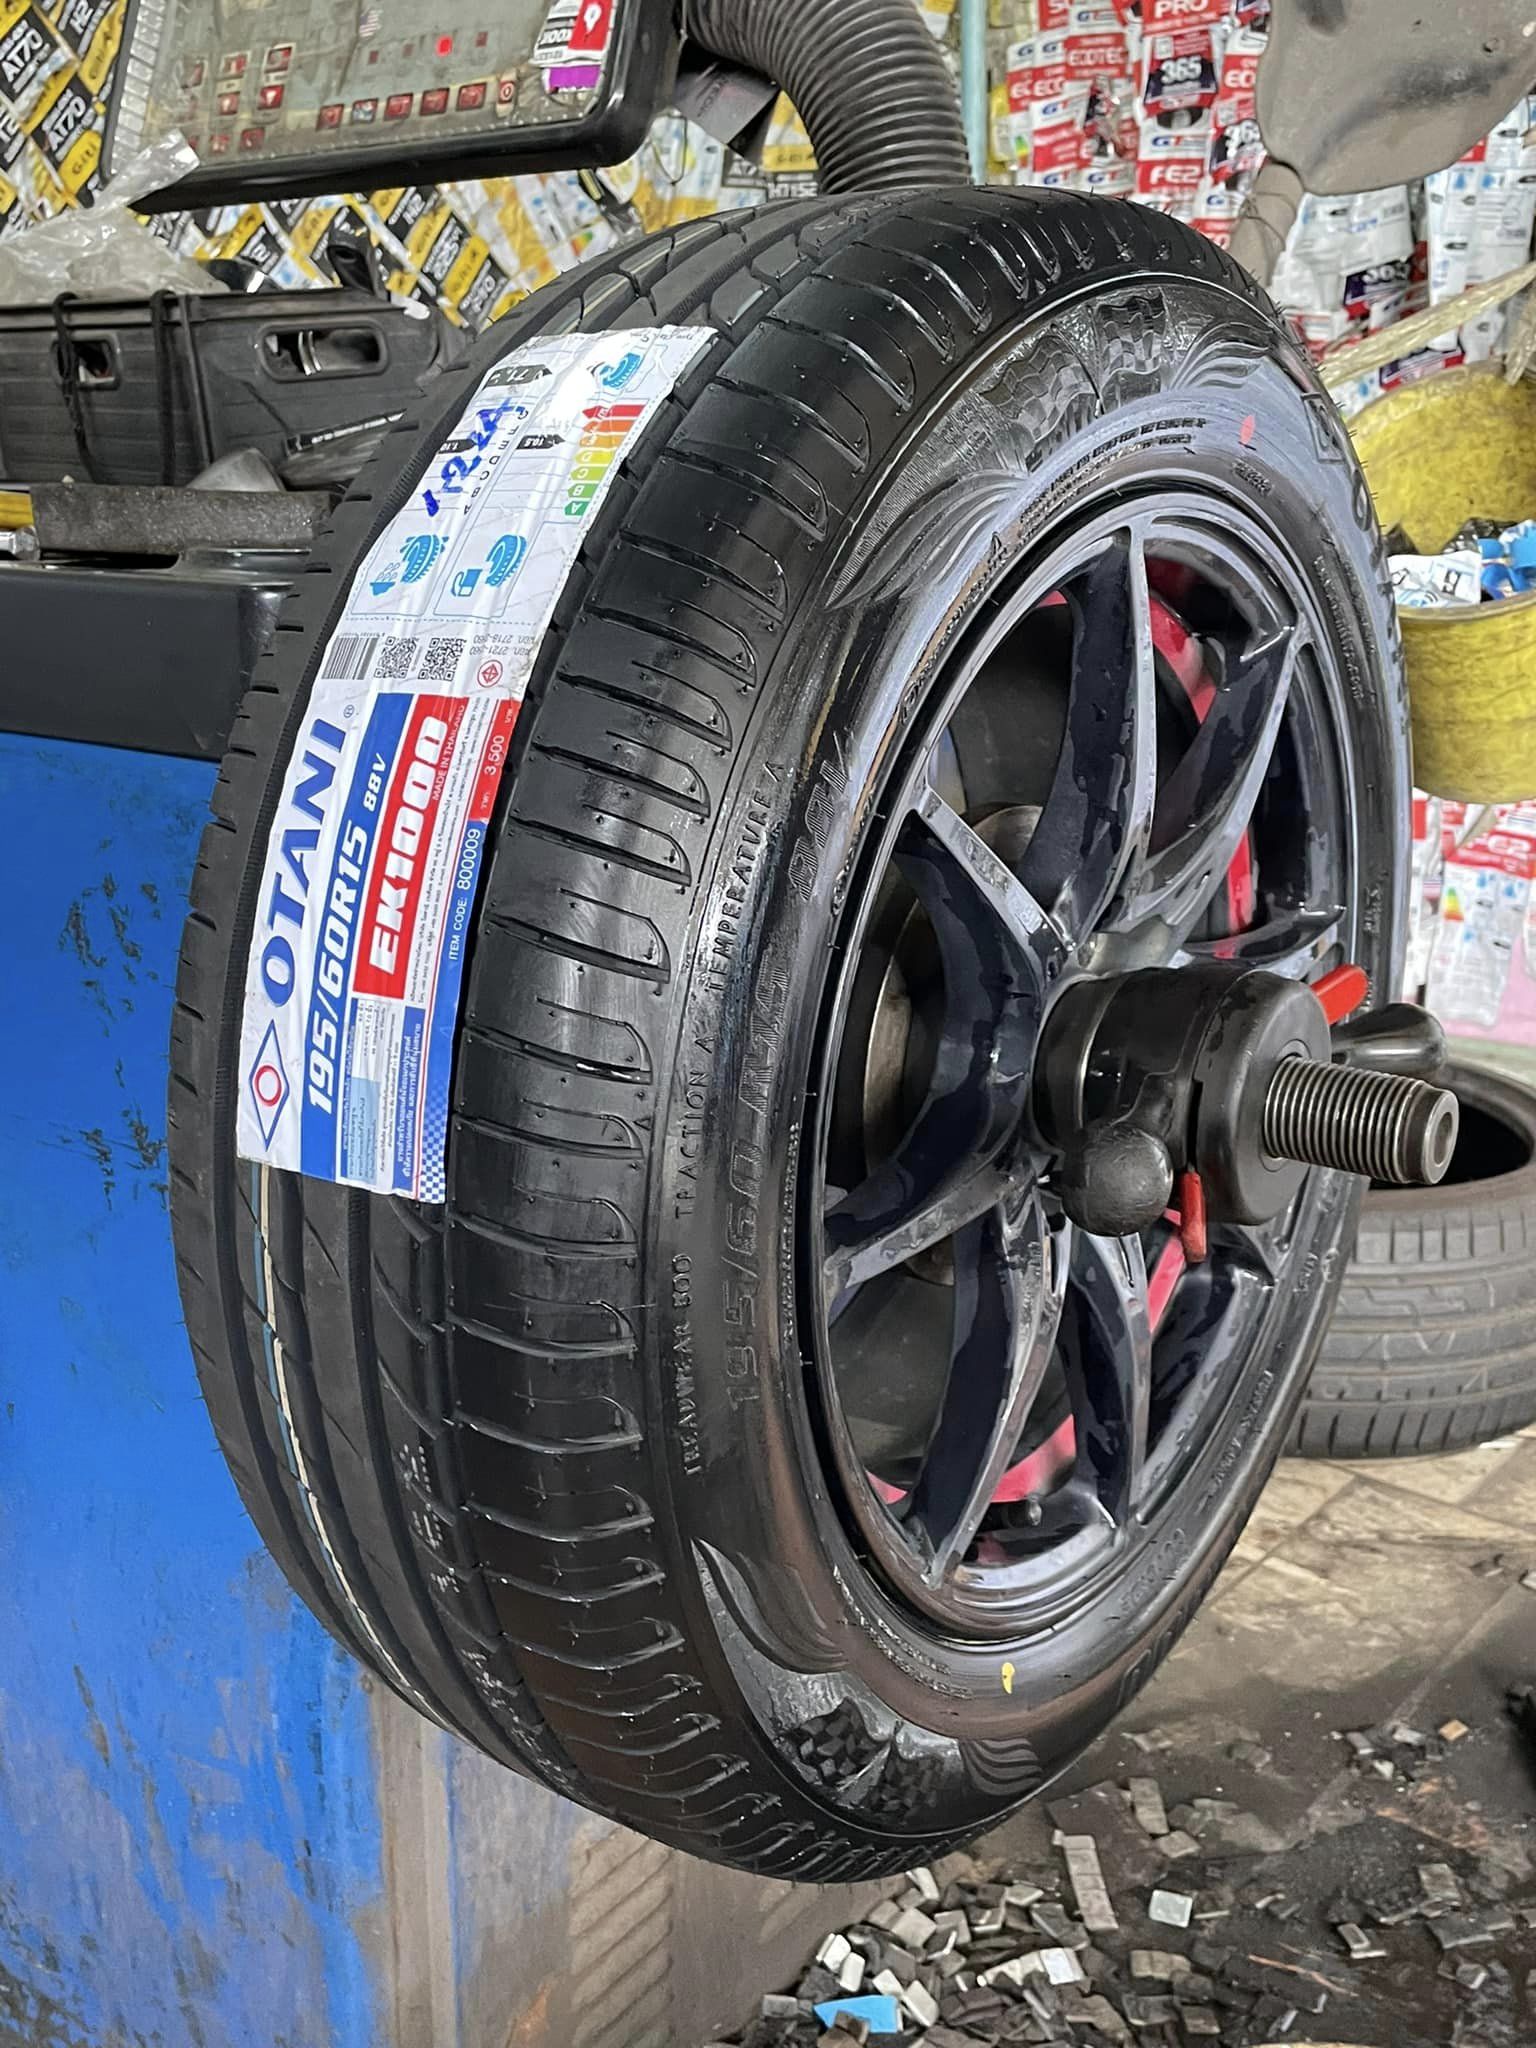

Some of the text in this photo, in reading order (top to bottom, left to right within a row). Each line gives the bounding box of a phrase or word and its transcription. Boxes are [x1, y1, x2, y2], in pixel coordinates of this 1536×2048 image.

[1, 28, 43, 83] AT70
[1160, 55, 1202, 84] 365
[48, 95, 87, 151] AT70
[489, 455, 500, 465] D
[479, 470, 490, 481] C
[471, 487, 480, 498] B
[572, 486, 584, 497] B
[569, 502, 579, 514] A
[762, 759, 785, 783] A
[432, 772, 444, 800] MADE
[369, 716, 448, 976] EK1000
[261, 718, 347, 1007] OTANI
[448, 828, 481, 961] ITEM CODE: 800009
[703, 793, 772, 993] TEMPERATURE
[307, 819, 369, 1115] 195/60R15
[363, 752, 387, 813] 88V
[695, 1034, 716, 1054] A
[674, 1069, 710, 1220] TRACTION
